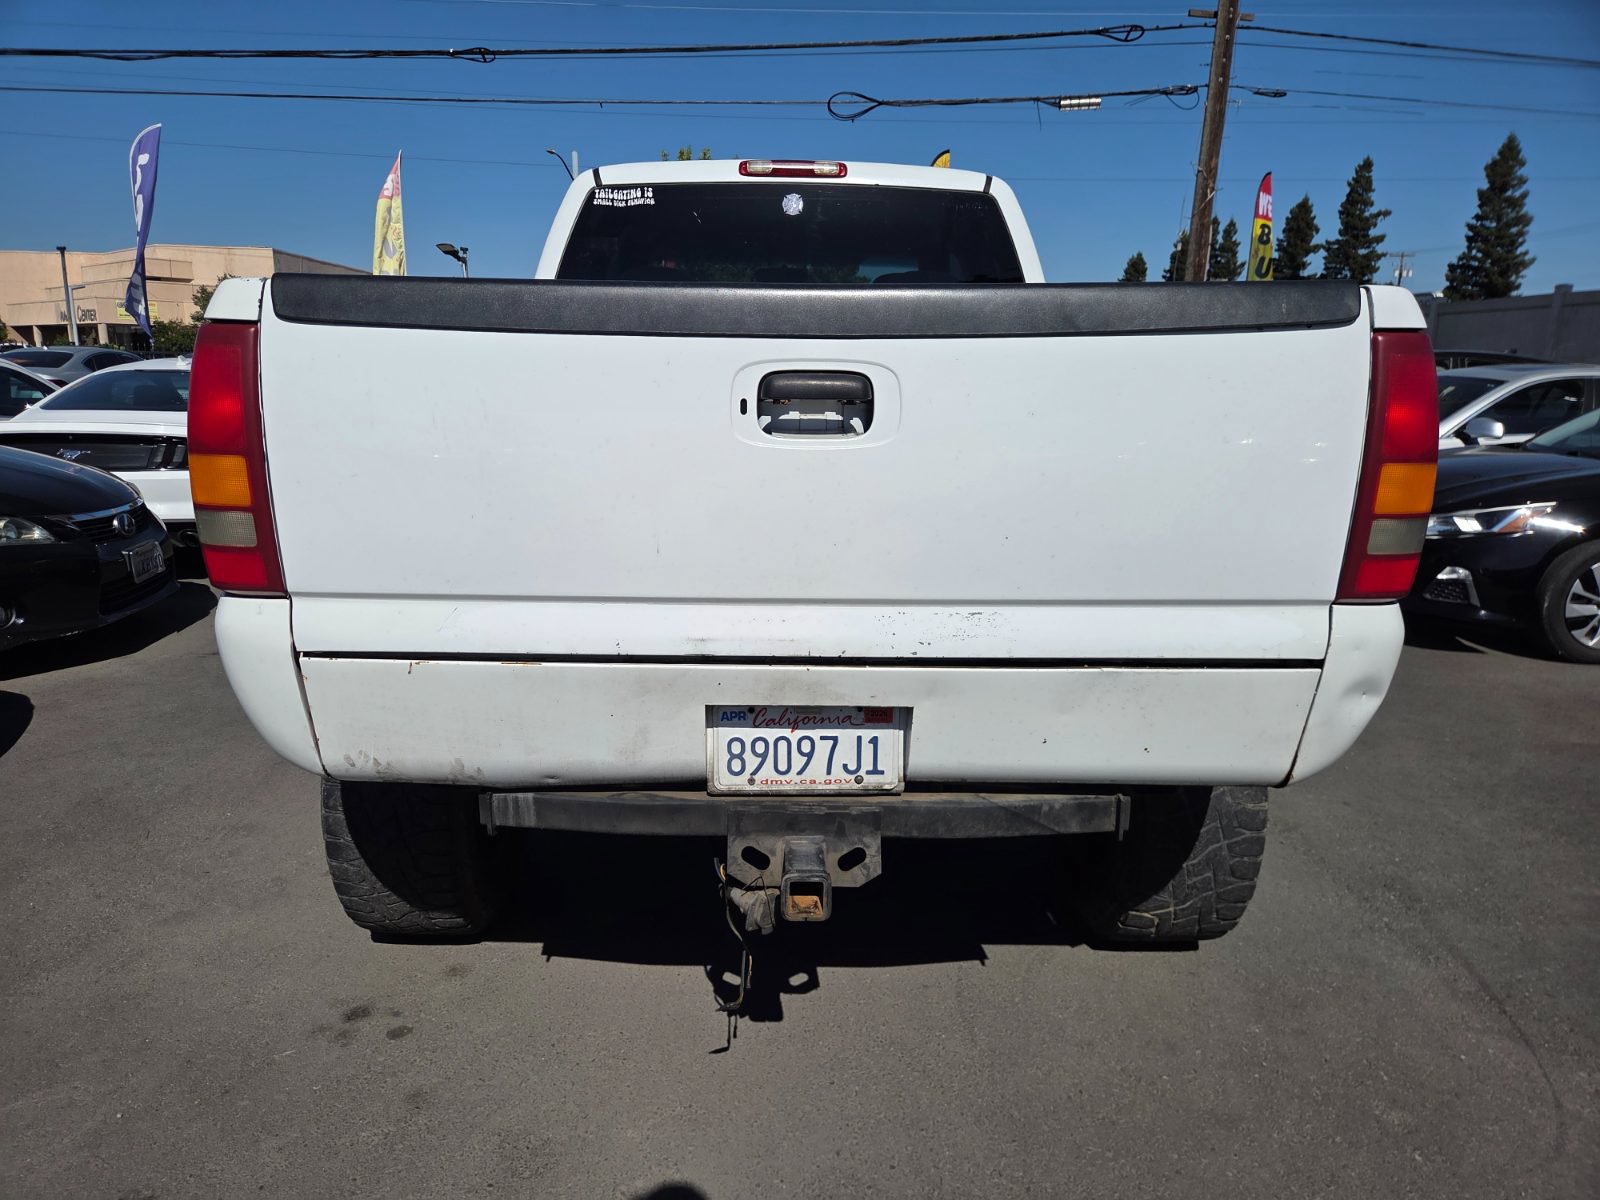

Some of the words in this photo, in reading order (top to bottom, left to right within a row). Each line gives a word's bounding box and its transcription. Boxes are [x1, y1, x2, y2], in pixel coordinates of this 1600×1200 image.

[721, 711, 746, 722] APR
[752, 708, 865, 733] California
[726, 735, 885, 776] 89097J1
[760, 777, 852, 785] dmv.ca.gov
